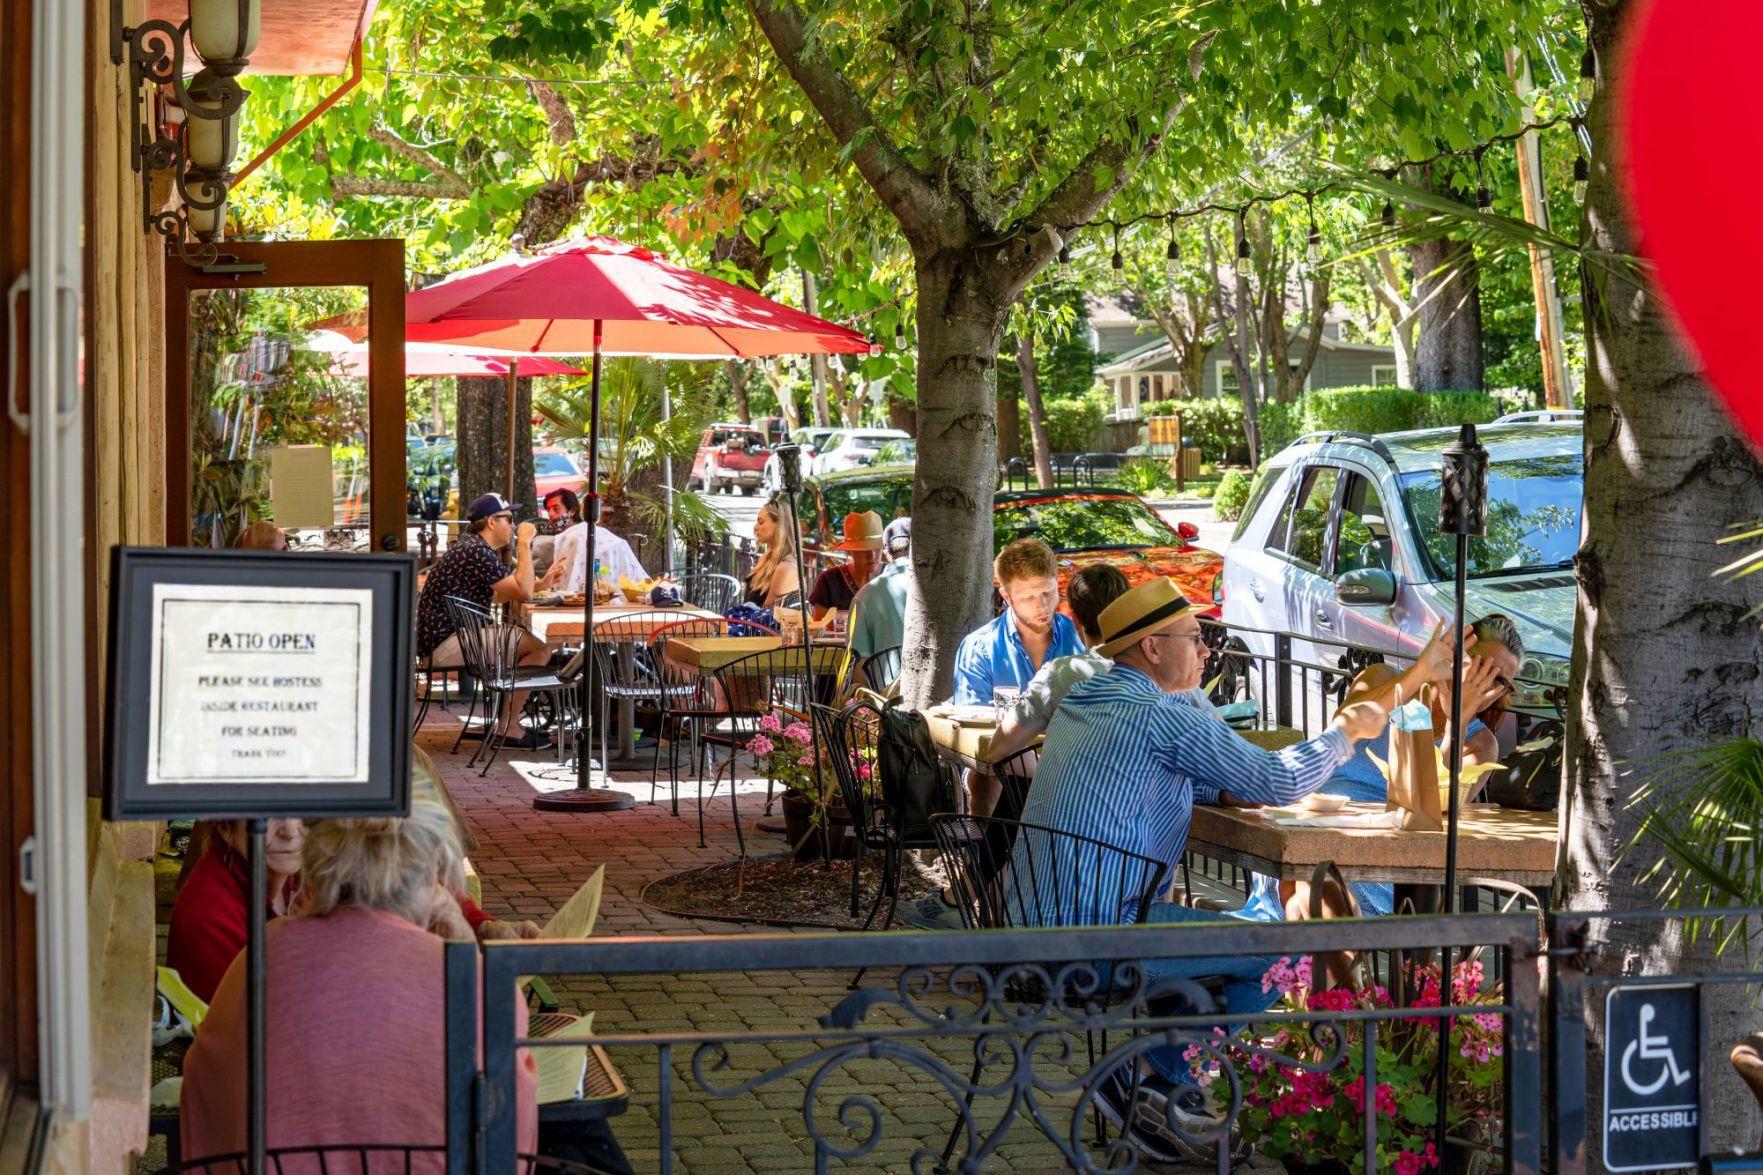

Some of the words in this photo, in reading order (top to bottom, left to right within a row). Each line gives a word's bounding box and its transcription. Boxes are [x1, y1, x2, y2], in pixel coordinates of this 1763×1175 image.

[207, 632, 263, 649] PATIO
[268, 633, 316, 650] OPEN
[198, 676, 243, 687] PLEASE
[247, 676, 269, 687] SEE
[273, 676, 322, 688] HOSTESS
[241, 701, 318, 712] RESTAURANT
[221, 726, 243, 737] FOR
[247, 726, 297, 737] SEATING
